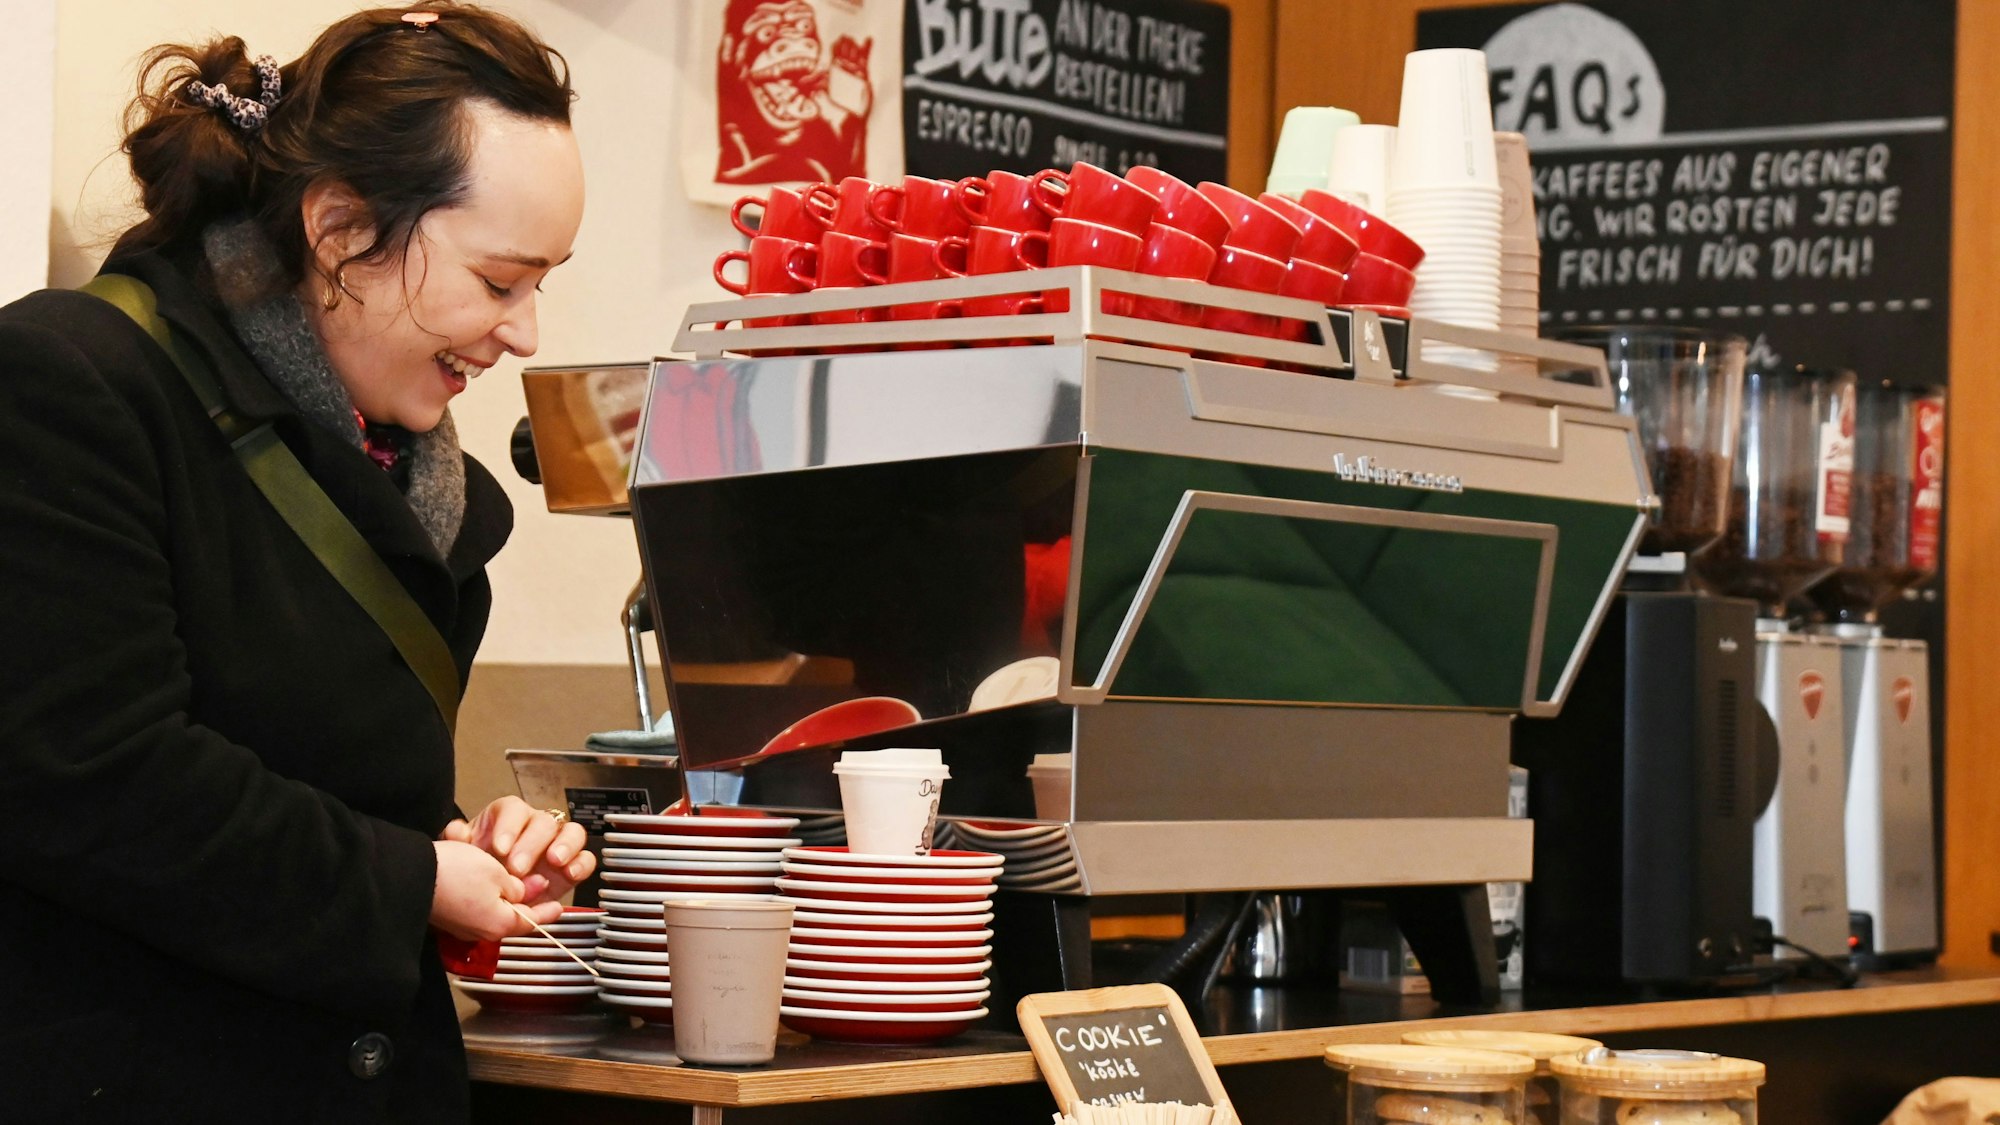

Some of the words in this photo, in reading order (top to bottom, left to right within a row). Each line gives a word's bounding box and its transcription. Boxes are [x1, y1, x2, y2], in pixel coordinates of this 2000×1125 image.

[1091, 3, 1131, 60] DER
[1137, 15, 1206, 75] THEKE
[1054, 51, 1186, 124] BESTELLEN!
[917, 98, 1033, 158] ESPRESSO
[1531, 158, 1664, 201] KAFFEES
[1671, 152, 1738, 193] AUS
[1750, 142, 1890, 192] EIGENER
[1593, 203, 1657, 238] WIR
[1665, 193, 1798, 234] RÖSTEN
[1812, 185, 1902, 226] JEDE
[1557, 243, 1682, 290] FRISCH
[1697, 233, 1760, 280] FÜR
[1770, 235, 1875, 280] DICH!
